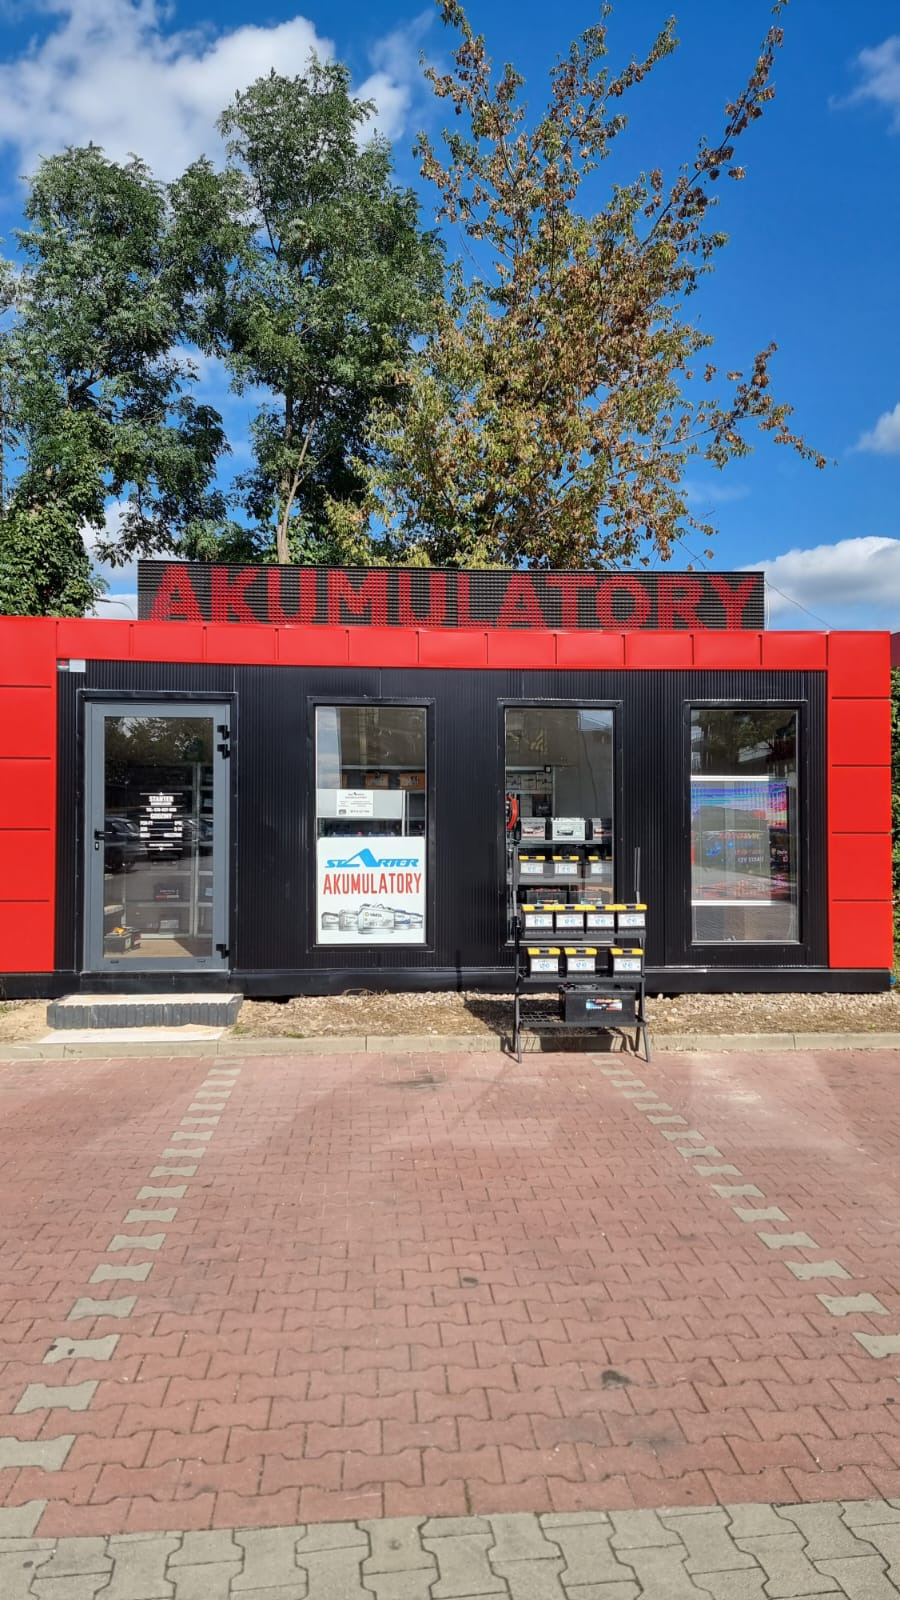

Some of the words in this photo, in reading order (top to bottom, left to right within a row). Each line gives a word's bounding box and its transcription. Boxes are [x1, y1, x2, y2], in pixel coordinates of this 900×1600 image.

[149, 565, 756, 629] AKUMULATORY
[324, 848, 419, 868] STARTER
[323, 872, 422, 895] AKUMULATORY
